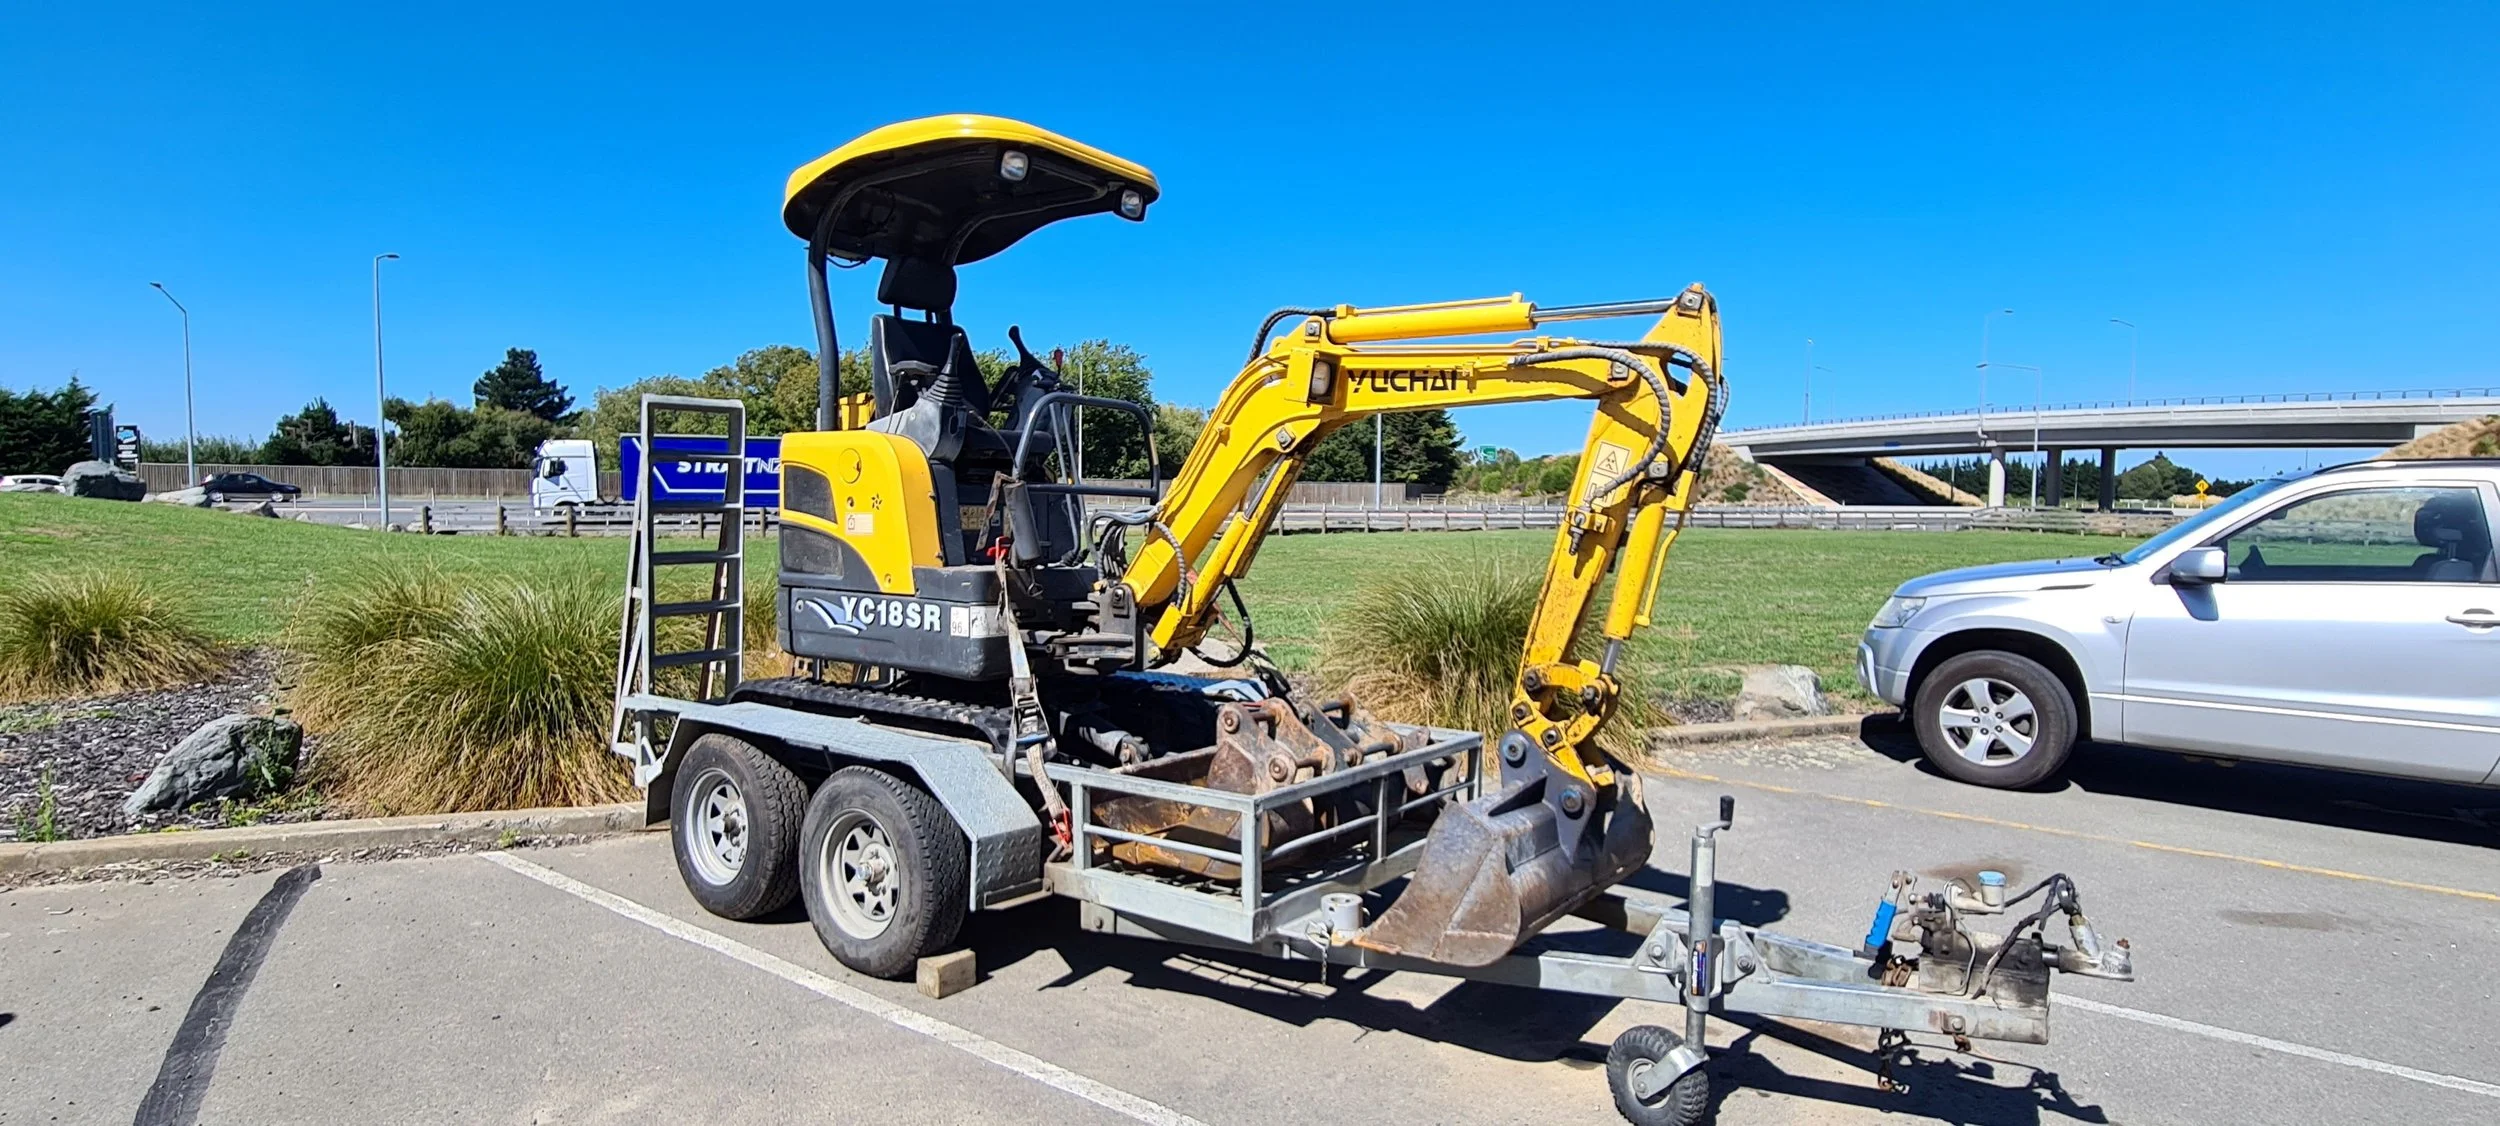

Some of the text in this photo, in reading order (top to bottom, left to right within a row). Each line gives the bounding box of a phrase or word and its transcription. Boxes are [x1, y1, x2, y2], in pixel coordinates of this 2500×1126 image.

[1347, 368, 1457, 393] YUCHAI
[676, 457, 781, 474] STRTNZ
[840, 595, 942, 632] YC18SR
